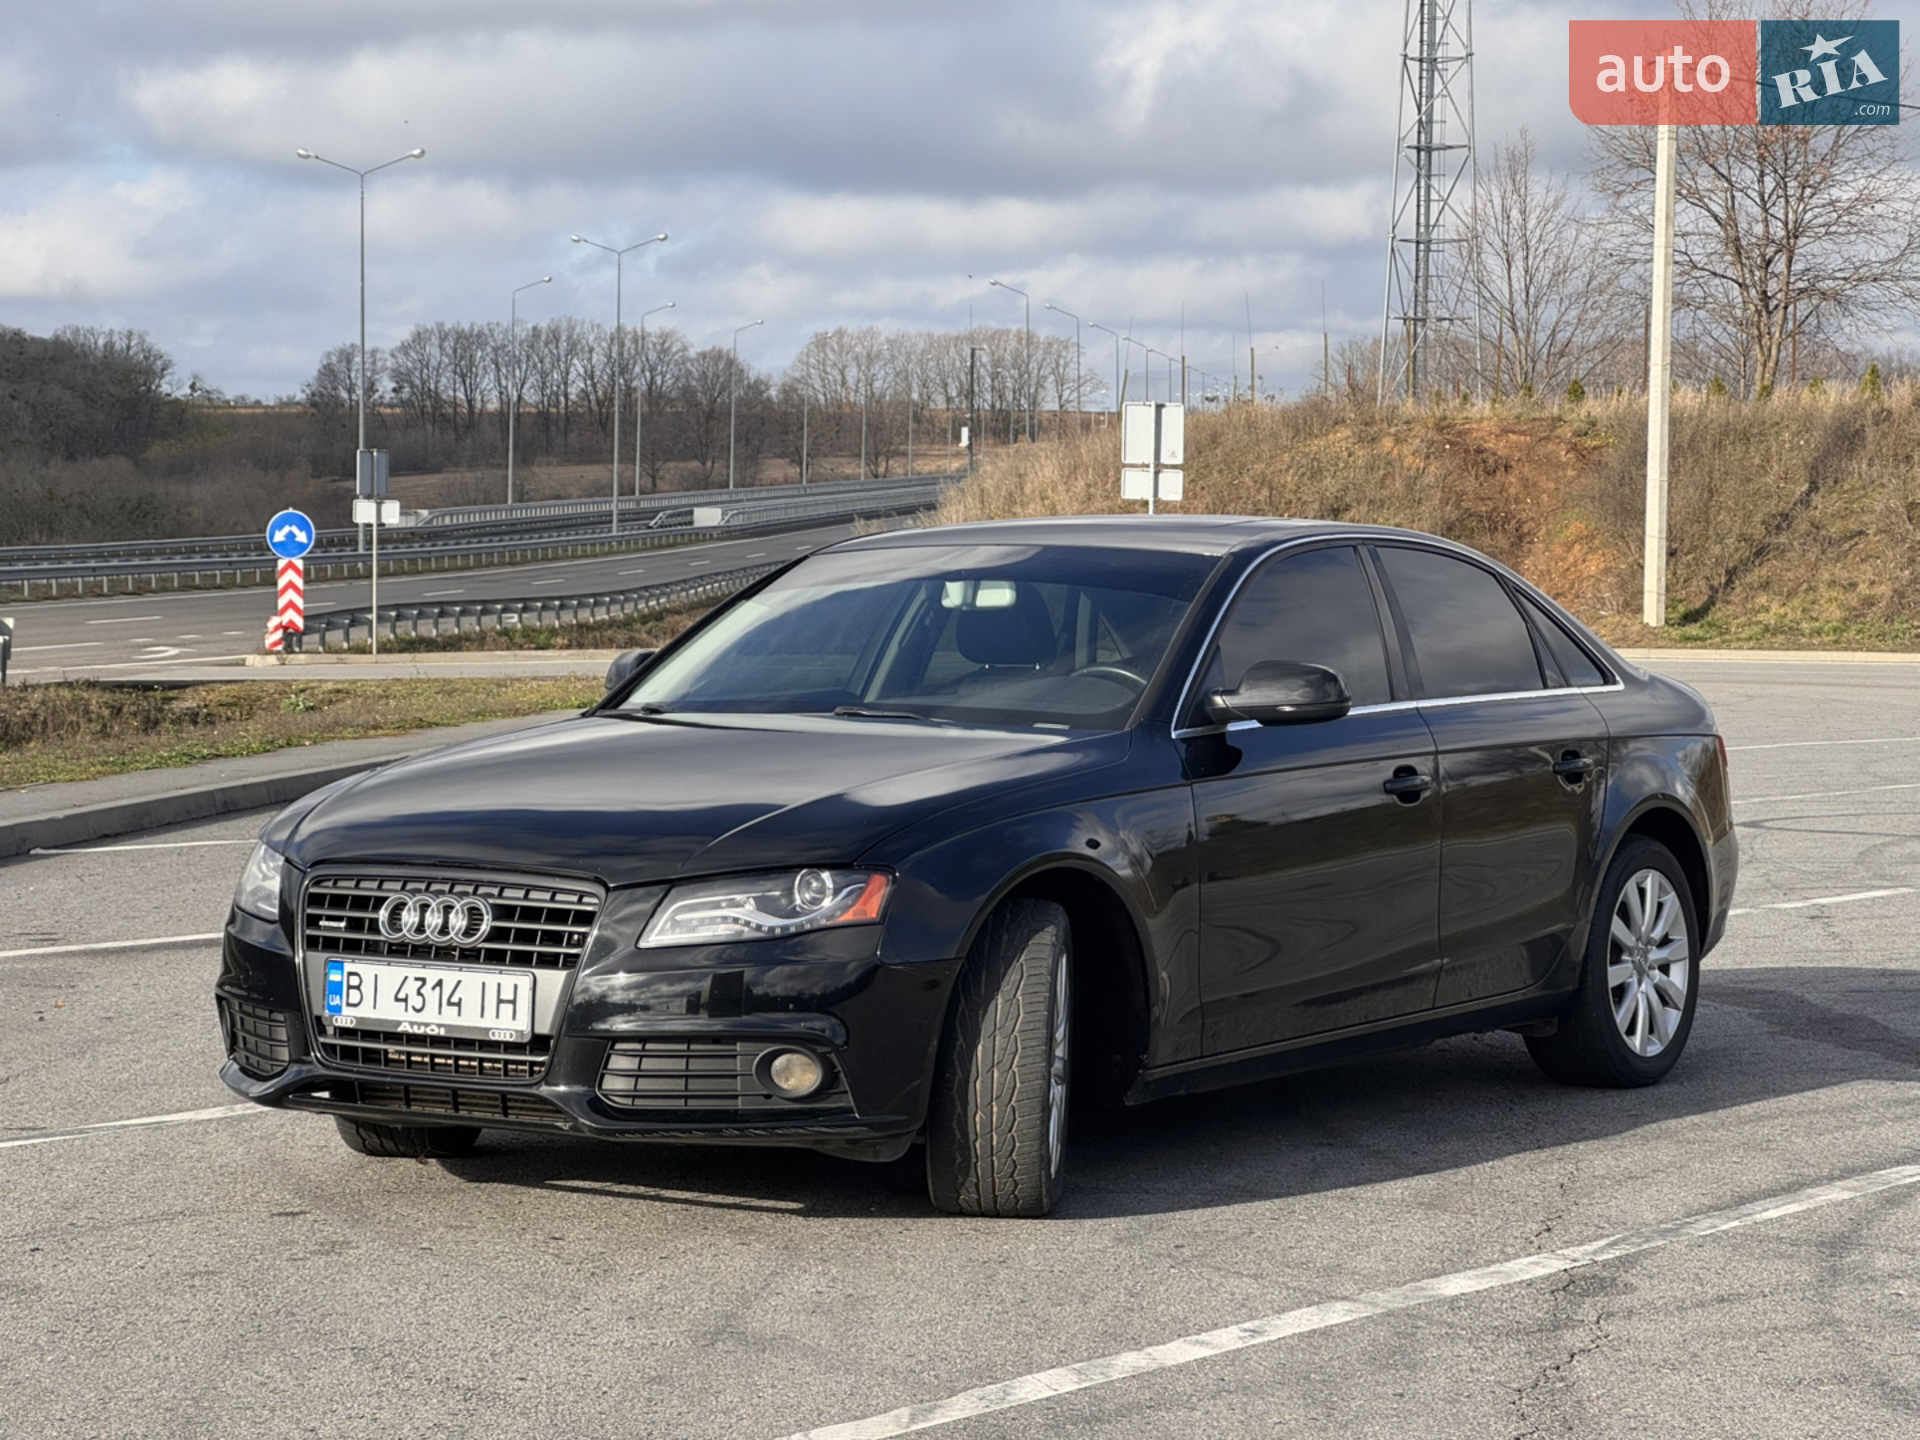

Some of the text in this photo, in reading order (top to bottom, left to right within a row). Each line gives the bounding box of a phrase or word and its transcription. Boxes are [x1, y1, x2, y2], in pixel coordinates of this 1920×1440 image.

[328, 994, 342, 1007] UA
[345, 971, 519, 1021] BI 4314 IH
[396, 1021, 446, 1036] Audi
